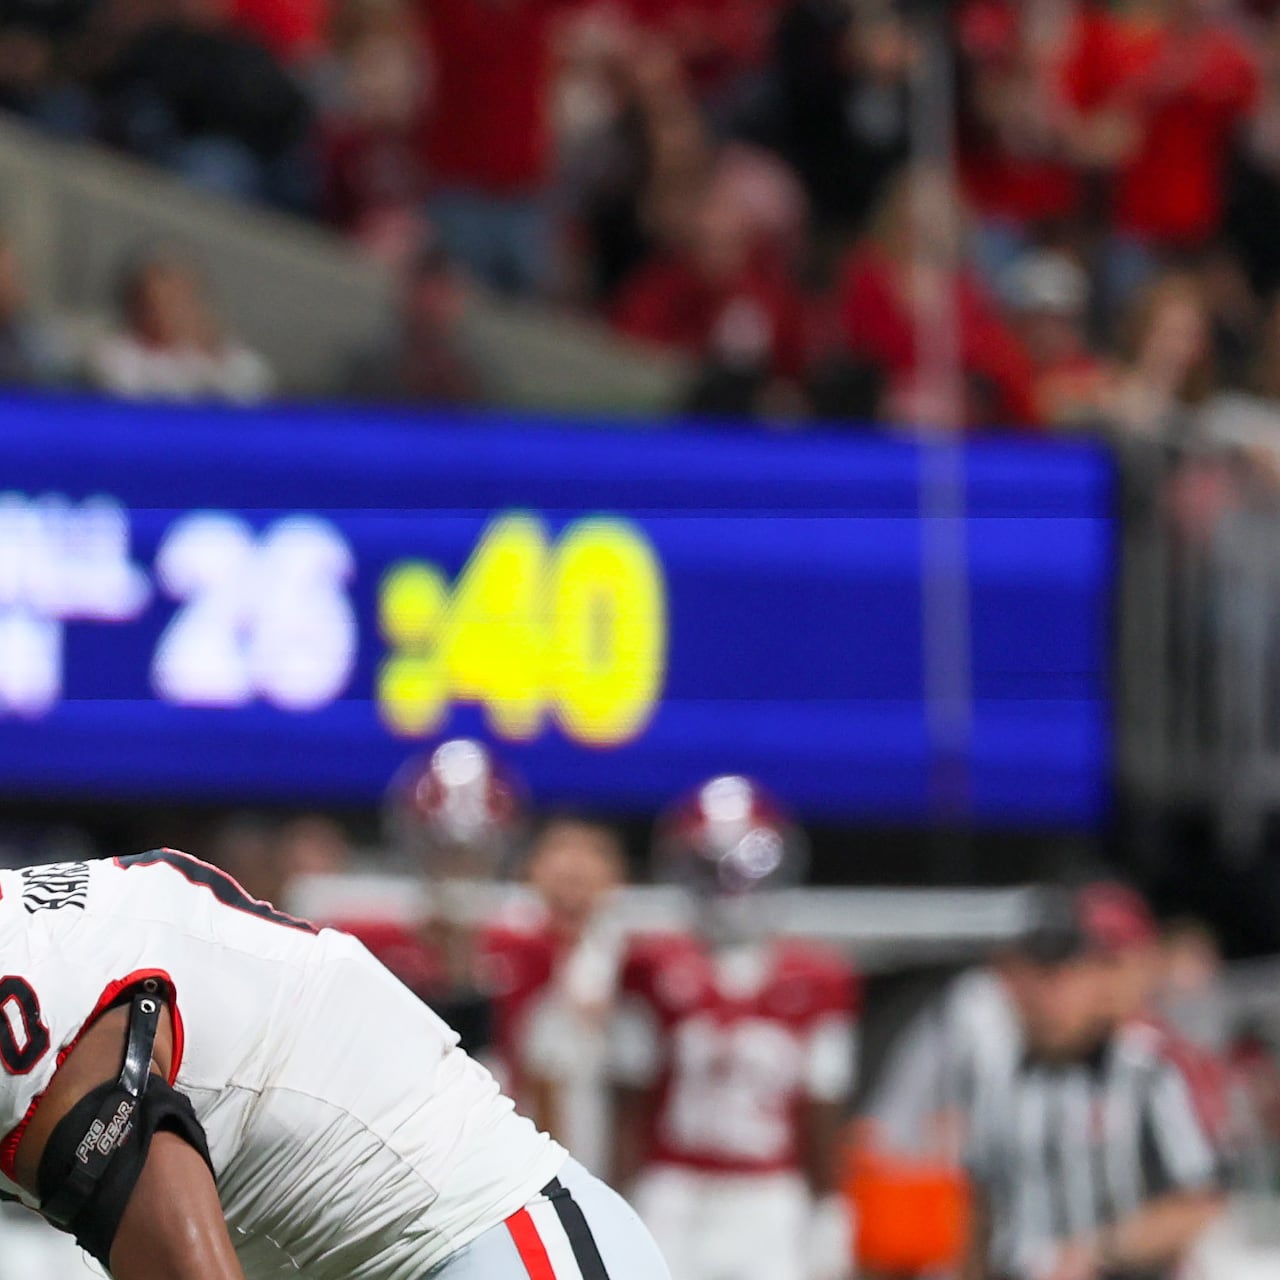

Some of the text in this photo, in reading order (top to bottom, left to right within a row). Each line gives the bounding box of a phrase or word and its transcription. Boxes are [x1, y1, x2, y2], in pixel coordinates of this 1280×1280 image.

[151, 509, 357, 711] 26
[378, 509, 666, 748] :40
[75, 1118, 105, 1164] PRO
[96, 1100, 134, 1156] GEAR
